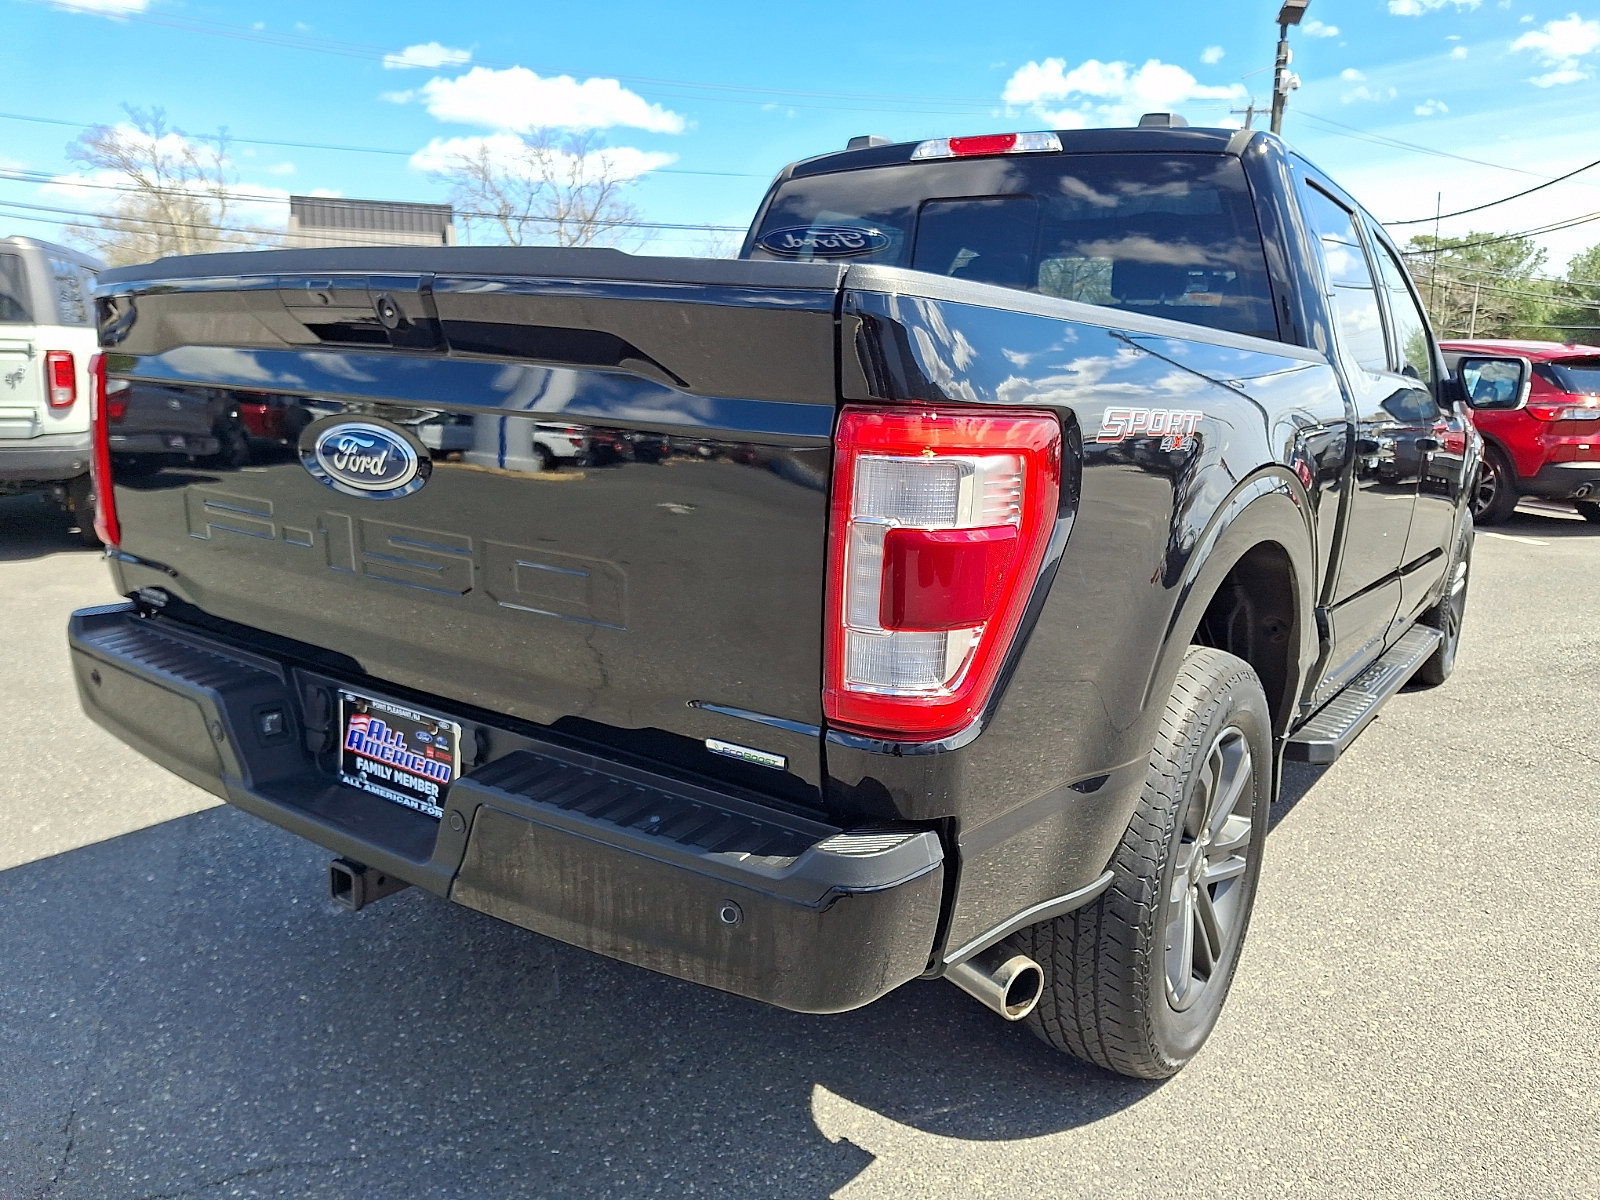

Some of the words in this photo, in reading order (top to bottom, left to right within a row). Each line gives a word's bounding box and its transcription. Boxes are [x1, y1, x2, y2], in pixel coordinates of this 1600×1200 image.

[1096, 406, 1204, 443] SPORT
[333, 435, 388, 476] Ford
[183, 485, 628, 631] F-150
[342, 776, 362, 789] ALL
[363, 784, 419, 809] AMERICAN
[420, 803, 444, 819] FOR
[355, 757, 393, 781] FAMILY
[393, 769, 440, 798] MEMBER
